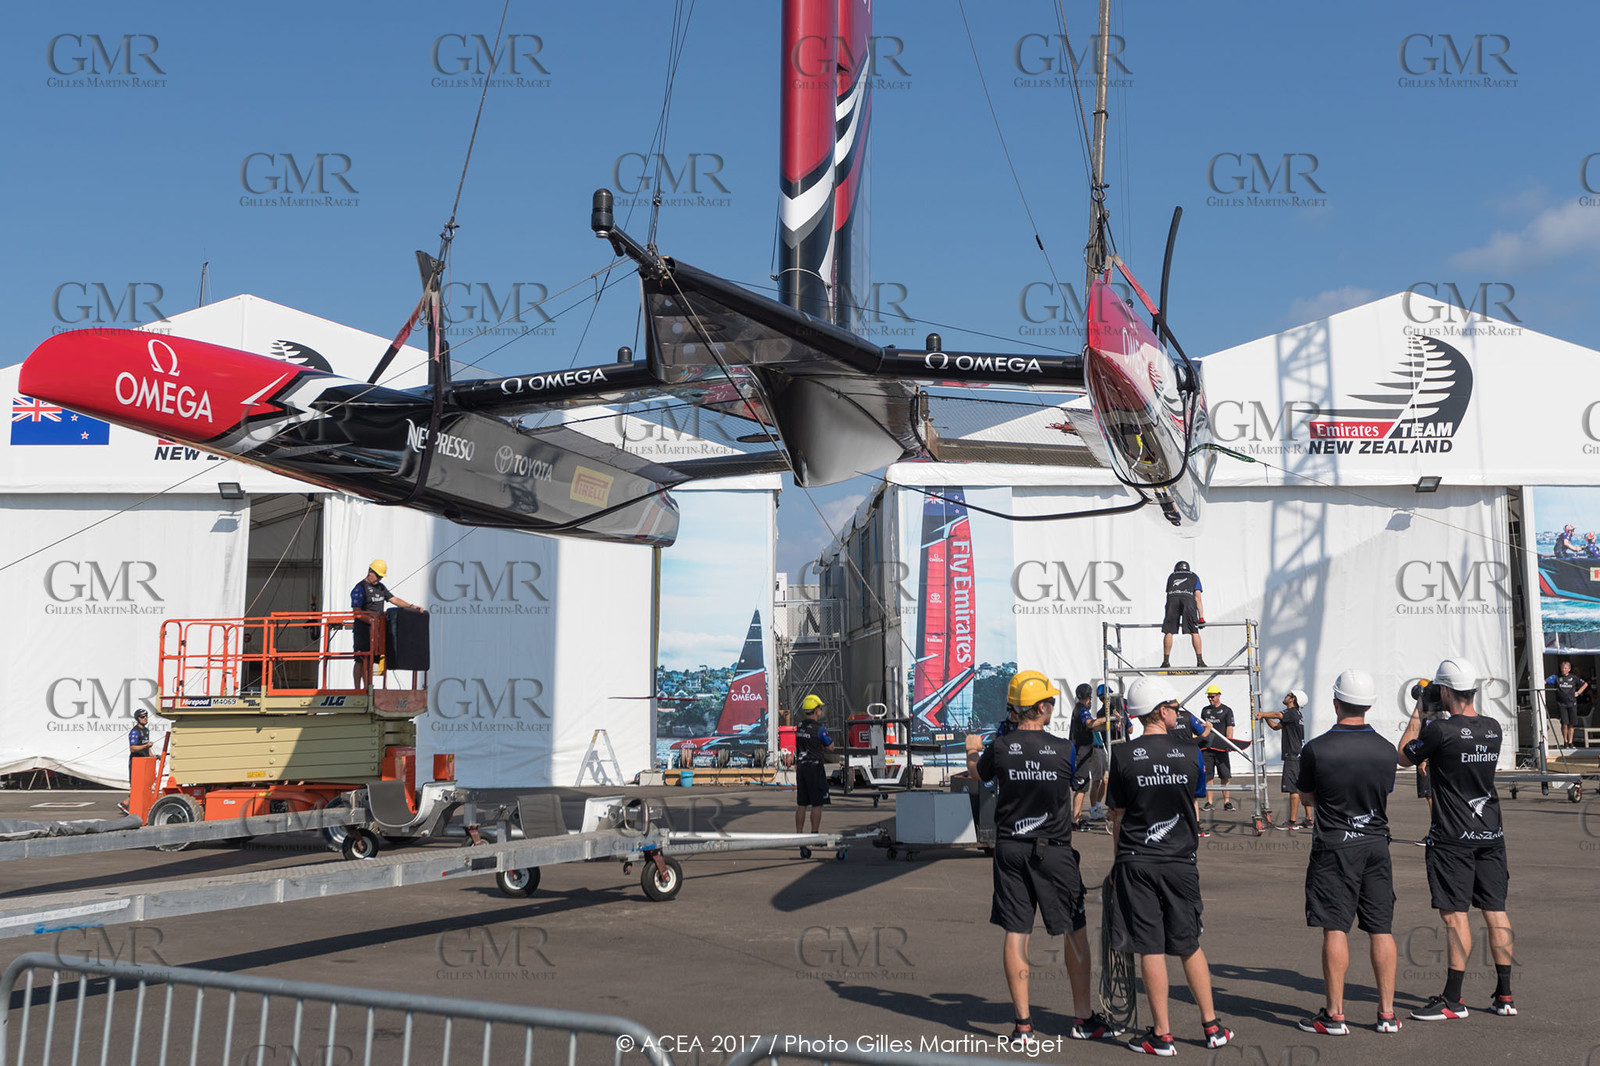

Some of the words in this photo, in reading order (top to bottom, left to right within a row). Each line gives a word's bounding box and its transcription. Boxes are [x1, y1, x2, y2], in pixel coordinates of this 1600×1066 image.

[955, 355, 1043, 374] OMEGA
[528, 368, 608, 391] OMEGA
[115, 372, 213, 423] OMEGA
[1316, 423, 1380, 438] Emirates
[1400, 422, 1453, 437] TEAM
[154, 446, 200, 461] NEW
[1308, 441, 1351, 455] NEW
[1358, 440, 1453, 454] ZEALAND
[513, 454, 553, 483] TOYOTA
[574, 473, 609, 501] PIRELLI
[950, 541, 970, 573] Fly
[954, 575, 974, 664] Emirates
[213, 698, 237, 706] M4069
[320, 696, 347, 707] JLG
[731, 693, 762, 702] OMEGA
[1475, 744, 1488, 753] Fly
[1025, 760, 1040, 770] Fly
[1461, 752, 1499, 763] Emirates
[1008, 769, 1058, 781] Emirates
[1153, 764, 1169, 774] Fly
[1136, 773, 1189, 787] Emirates
